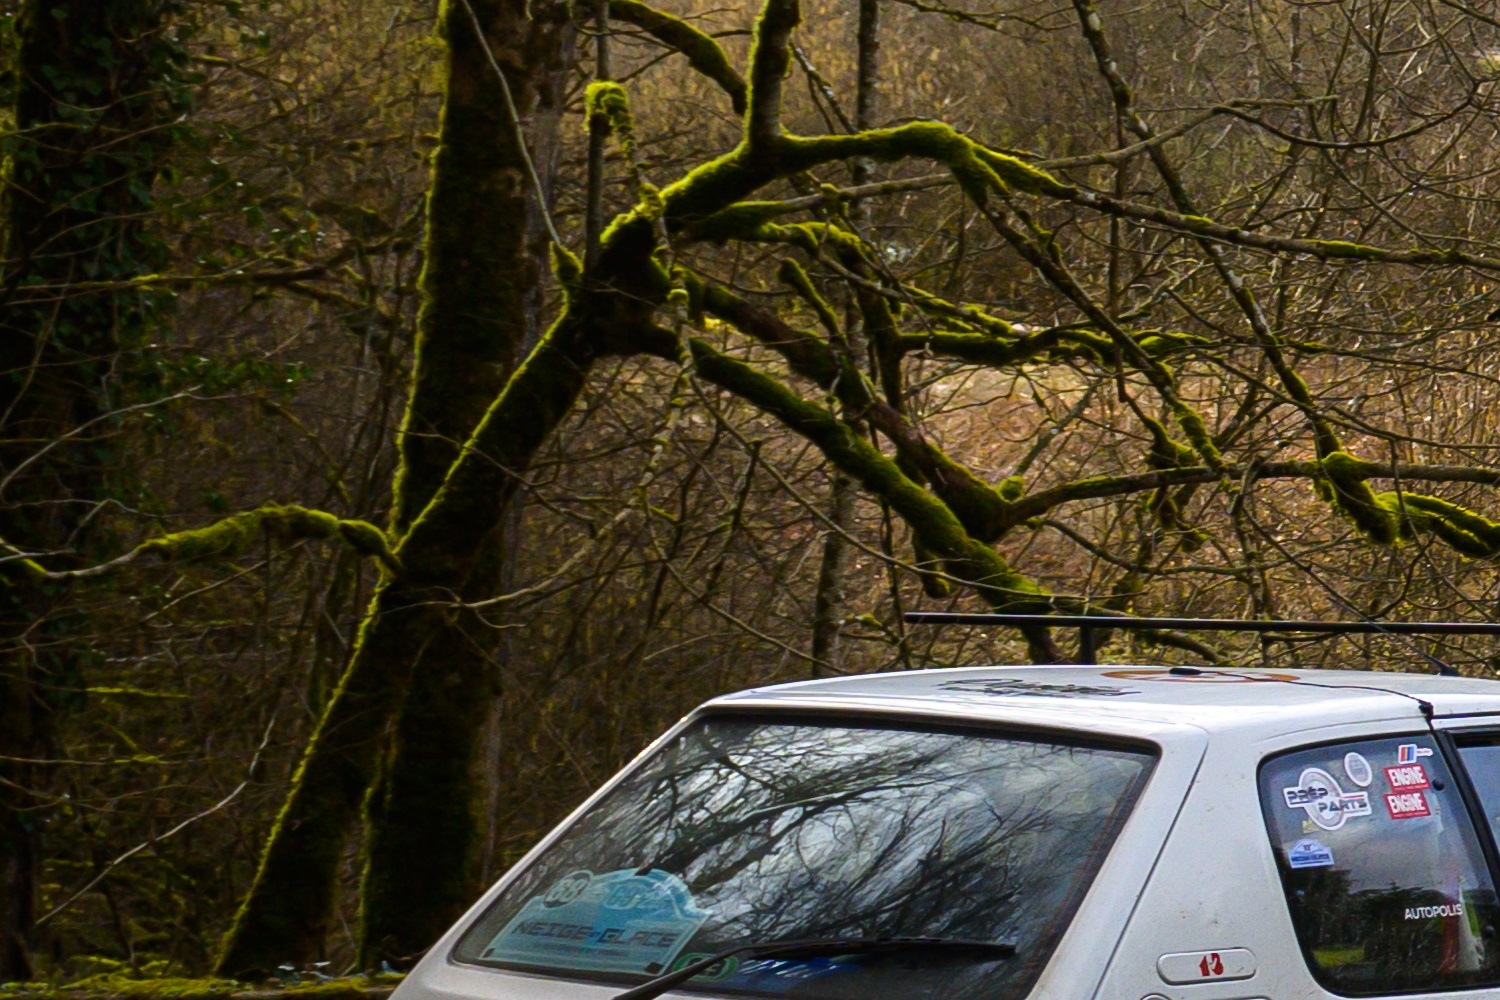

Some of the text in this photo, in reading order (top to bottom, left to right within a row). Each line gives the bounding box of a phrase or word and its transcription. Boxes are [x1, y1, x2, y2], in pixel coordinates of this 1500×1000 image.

[1388, 766, 1426, 786] ENGINE
[1388, 793, 1426, 814] ENGINE
[1404, 903, 1464, 920] AUTOPOLIS
[511, 920, 594, 940] NEIGE
[598, 928, 681, 948] GLACE
